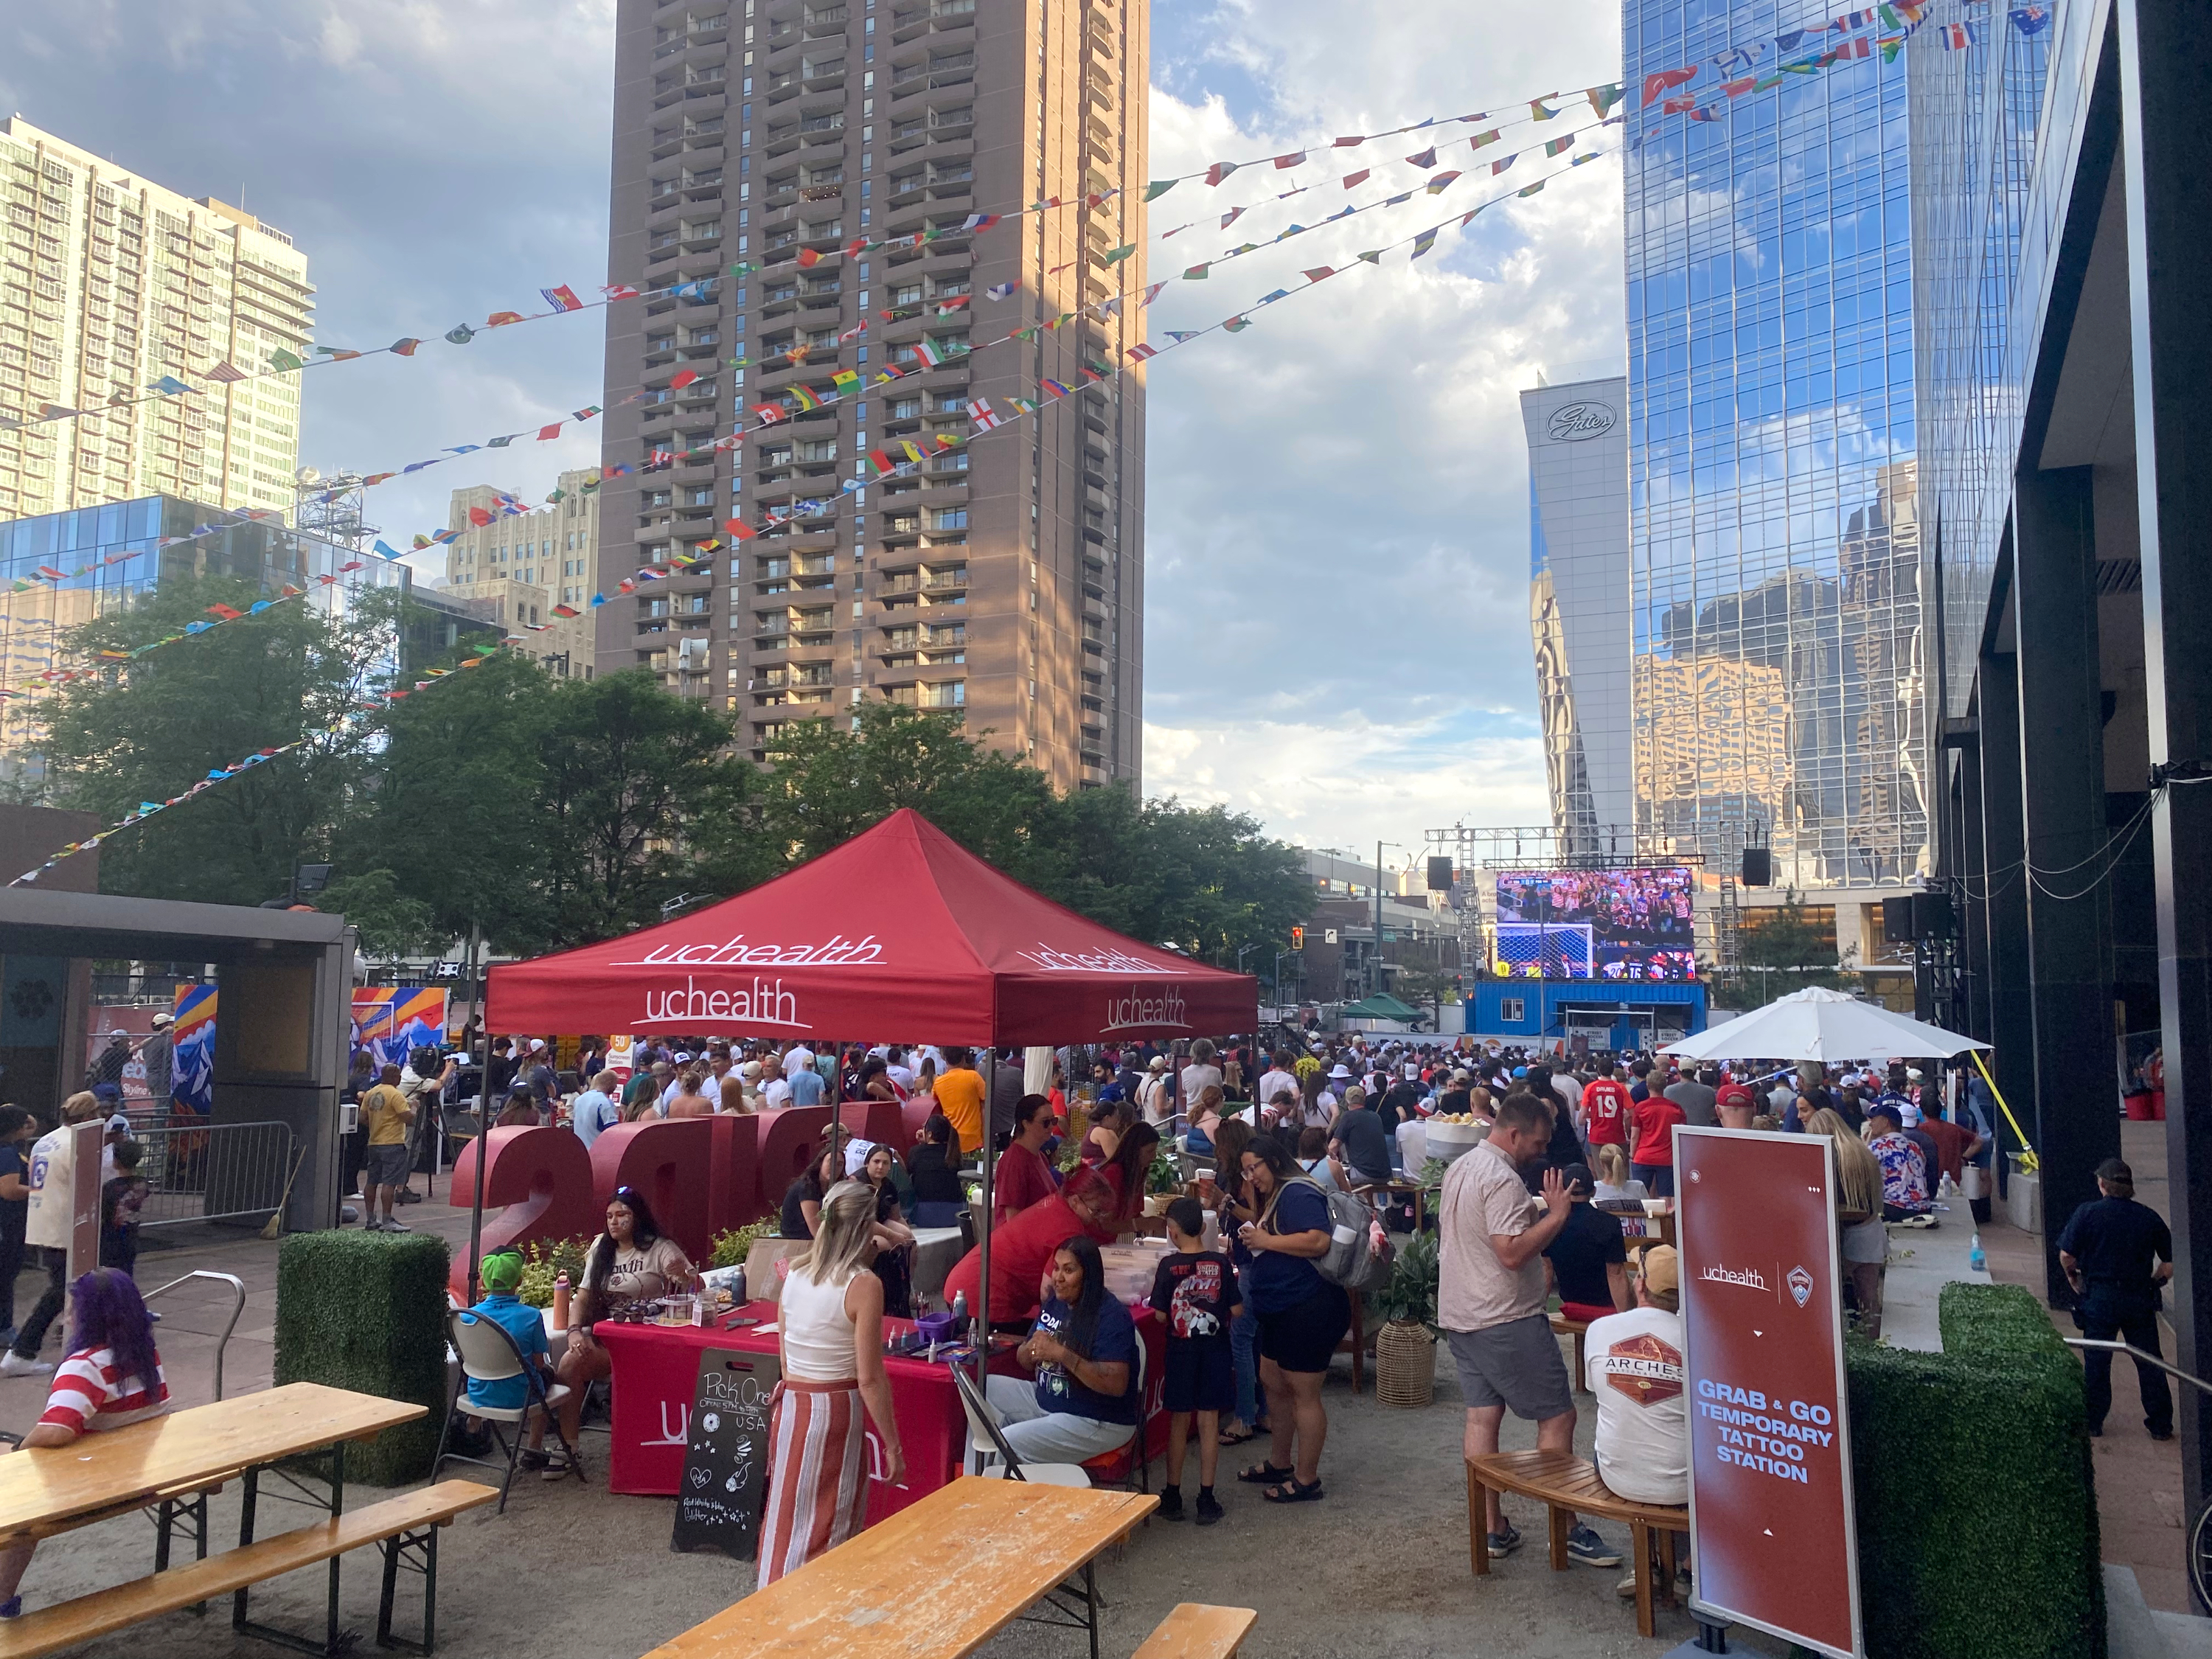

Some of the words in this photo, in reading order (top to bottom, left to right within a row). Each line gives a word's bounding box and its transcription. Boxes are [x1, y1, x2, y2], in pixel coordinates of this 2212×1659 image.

[1549, 405, 1610, 439] Gates
[643, 934, 883, 964] uchealth
[1016, 942, 1172, 973] uchealth
[645, 975, 797, 1024] uchealth
[1107, 984, 1185, 1027] uchealth
[122, 1083, 147, 1096] Skyline
[1596, 1095, 1618, 1118] 19
[1703, 1263, 1764, 1289] uchealth
[1610, 1368, 1652, 1377] NATIONAL
[704, 1372, 739, 1405] Pick
[741, 1377, 771, 1406] One
[1698, 1379, 1767, 1411] GRAB
[1773, 1400, 1783, 1411] &
[1790, 1400, 1832, 1426] GO
[736, 1416, 766, 1432] USA
[1697, 1400, 1833, 1448] TEMPORARY
[1718, 1425, 1804, 1461] TATTOO
[1717, 1445, 1808, 1484] STATION
[684, 1507, 707, 1522] Glitter
